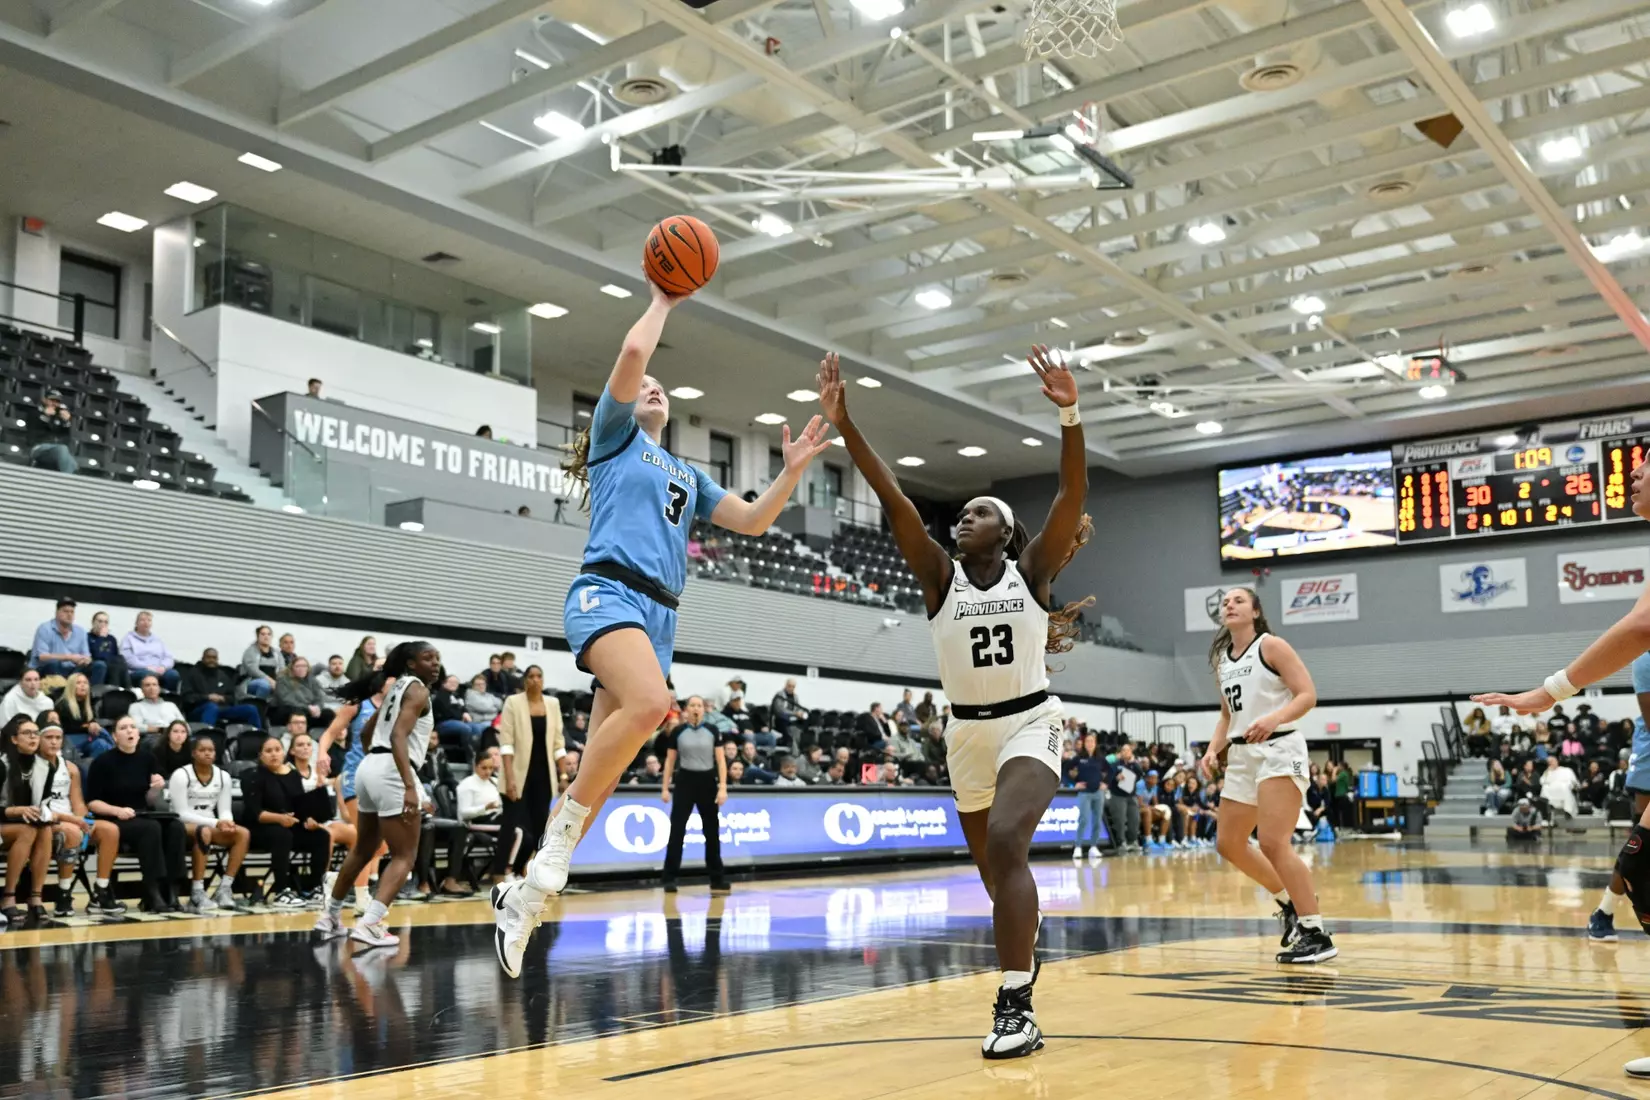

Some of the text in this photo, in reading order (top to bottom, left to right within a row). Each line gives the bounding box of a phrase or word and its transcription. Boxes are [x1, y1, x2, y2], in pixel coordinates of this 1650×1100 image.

[1579, 418, 1632, 439] FRIARS
[294, 410, 425, 467] WELCOME
[432, 440, 462, 474] TO
[1404, 438, 1479, 463] PROVIDENCE
[1514, 447, 1551, 469] 1:09
[642, 451, 697, 489] COLUMB
[1518, 482, 1531, 499] 2
[1565, 473, 1593, 495] 26
[664, 480, 690, 527] 3
[1466, 485, 1491, 506] 30
[1296, 579, 1342, 595] BIG
[954, 598, 1025, 620] PROVIDENCE
[1290, 592, 1354, 608] EAST
[970, 623, 1015, 668] 23
